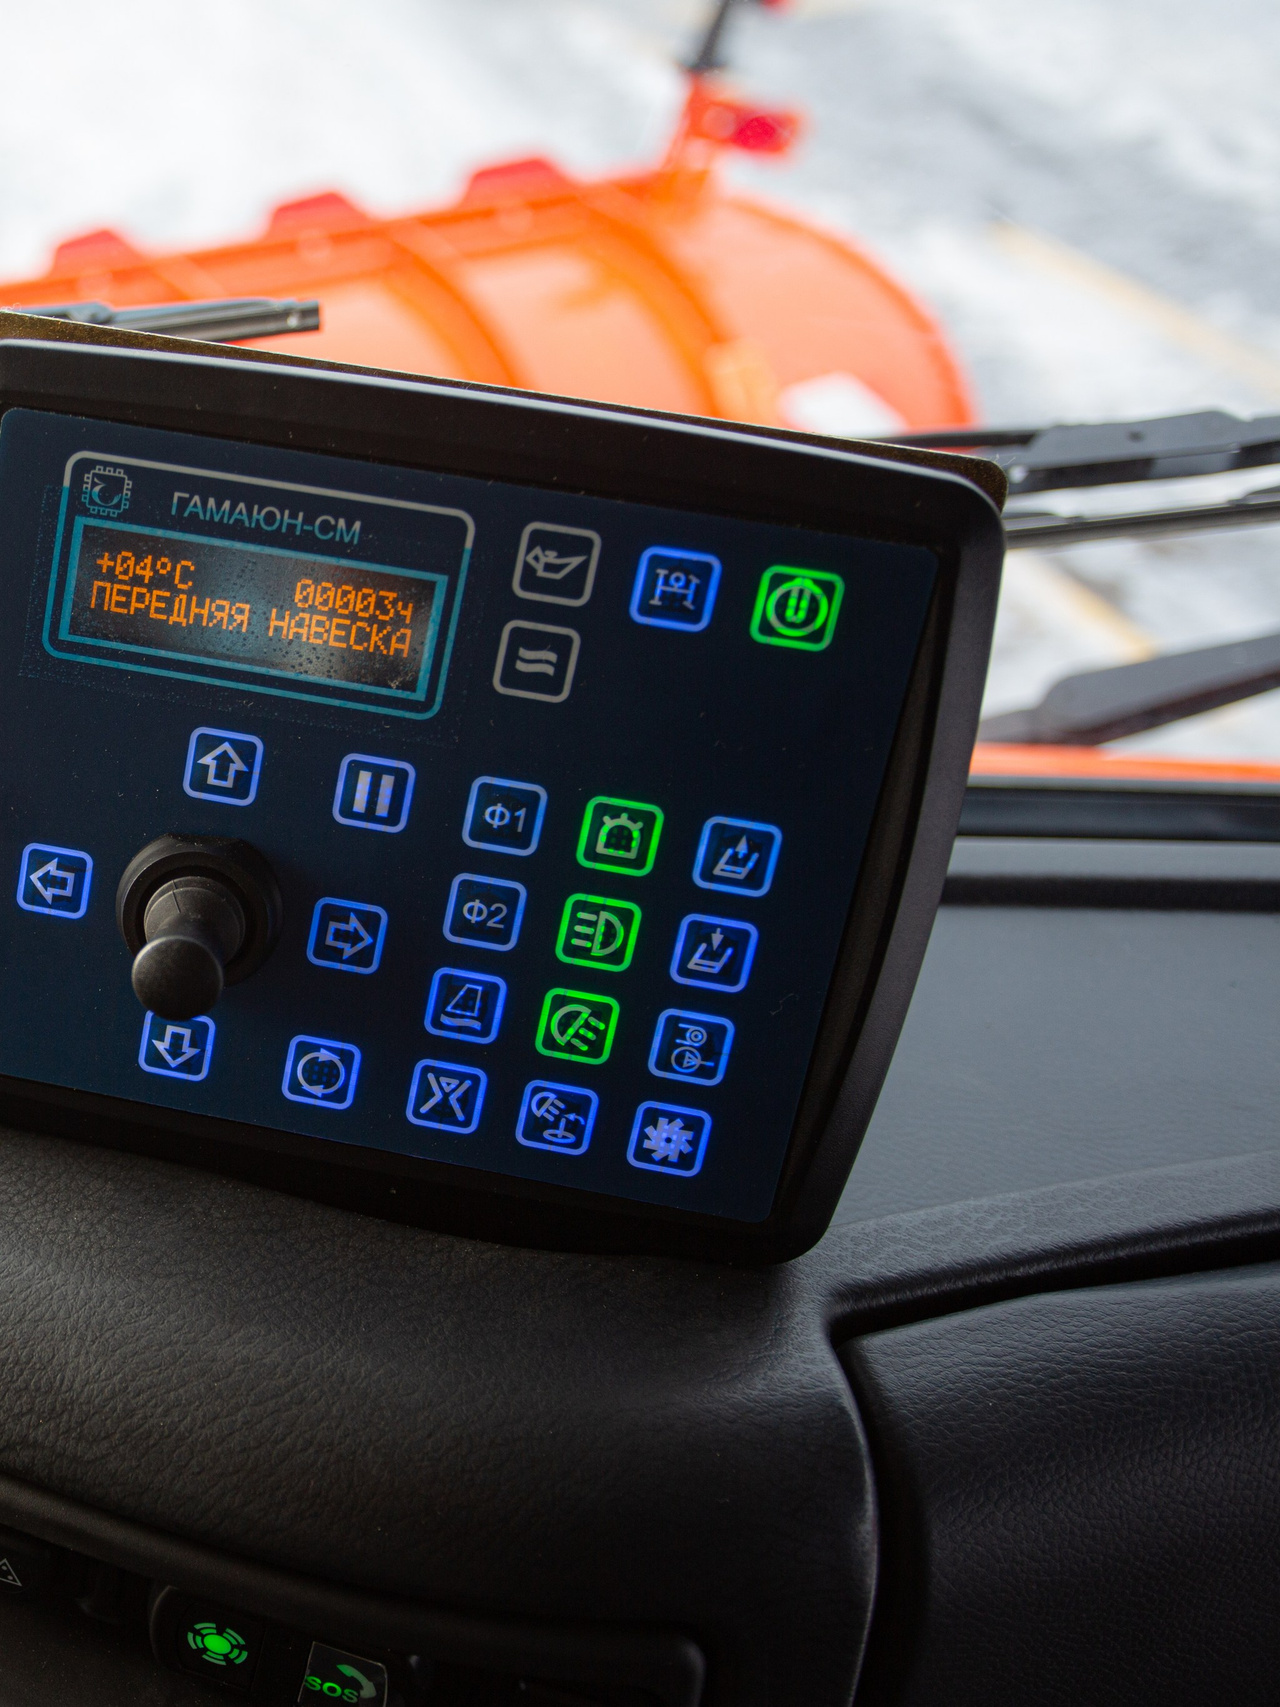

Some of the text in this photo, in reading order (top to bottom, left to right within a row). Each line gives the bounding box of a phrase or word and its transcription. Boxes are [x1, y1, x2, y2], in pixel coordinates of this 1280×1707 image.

[171, 491, 362, 545] ГАМАЮН-СМ
[90, 580, 412, 658] ПЕРЕДНЯЯ НАВЕСКА
[483, 802, 528, 834] Ф1
[462, 897, 508, 930] Ф2
[304, 1675, 359, 1704] SOS
